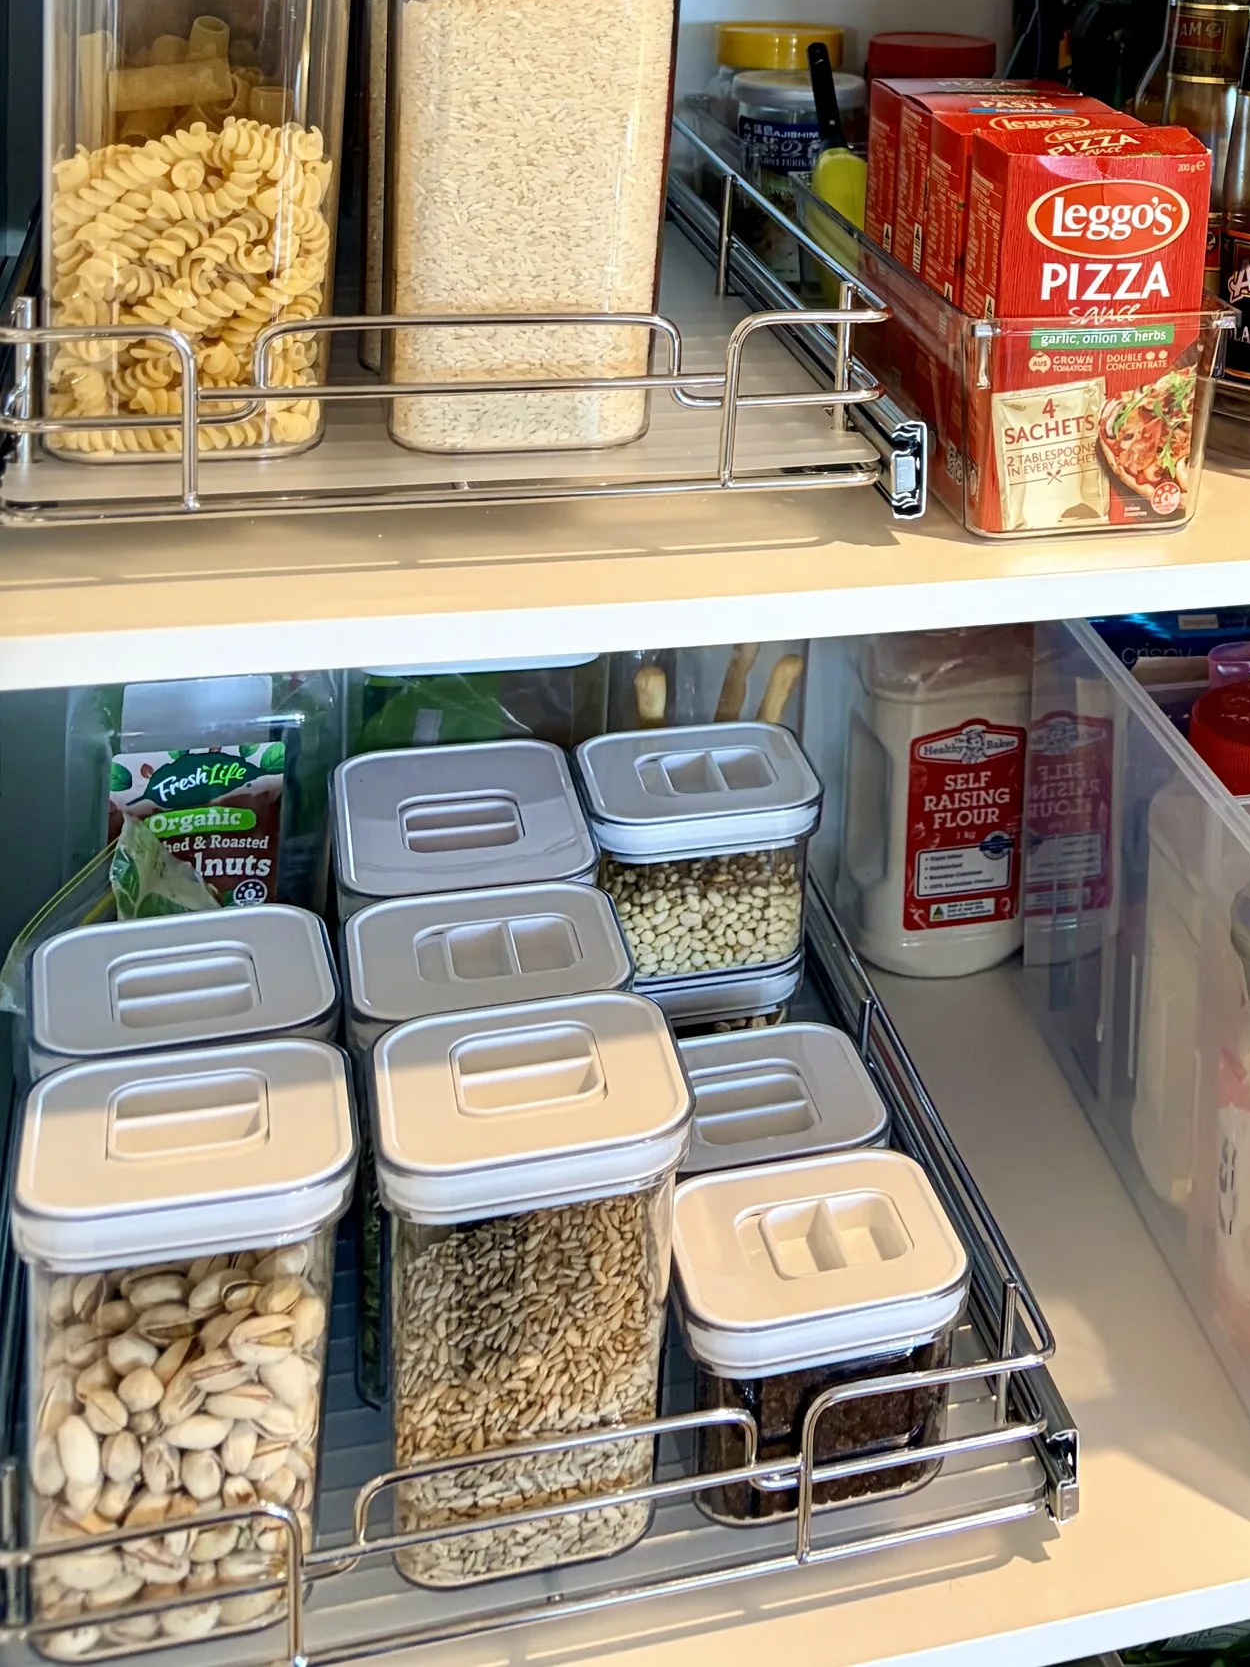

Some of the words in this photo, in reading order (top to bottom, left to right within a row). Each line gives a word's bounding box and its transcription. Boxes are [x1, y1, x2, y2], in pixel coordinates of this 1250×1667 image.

[980, 99, 1058, 109] PASTE
[773, 130, 819, 139] AJISHIM
[1047, 134, 1141, 156] PIZZA
[1177, 164, 1190, 172] 200
[1052, 196, 1174, 241] Leggo's
[1040, 260, 1171, 301] PIZZA
[1068, 303, 1141, 326] sauce
[1040, 332, 1080, 346] garlic,
[1082, 330, 1117, 344] onion
[1121, 330, 1132, 343] &
[1134, 328, 1167, 342] herbs
[1033, 359, 1048, 367] AUS
[1053, 355, 1094, 364] GROWN
[1053, 364, 1093, 372] TOMATOES
[1105, 359, 1168, 372] CONCENTRATE
[1106, 353, 1143, 363] DOUBLE
[1042, 398, 1056, 419] 4
[1005, 414, 1096, 445] SACHETS
[1007, 456, 1015, 467] 2
[1017, 444, 1097, 465] TABLESPOONS
[1007, 467, 1021, 477] IN
[1024, 462, 1054, 475] EVERY
[1057, 453, 1099, 471] SACHET
[923, 743, 963, 755] Healthy
[986, 739, 1016, 750] Baker
[944, 771, 992, 791] SELF
[924, 788, 1010, 811] RAISING
[149, 809, 242, 833] Organic
[933, 808, 1000, 829] FLOUR
[194, 836, 206, 850] &
[210, 835, 270, 849] Roasted
